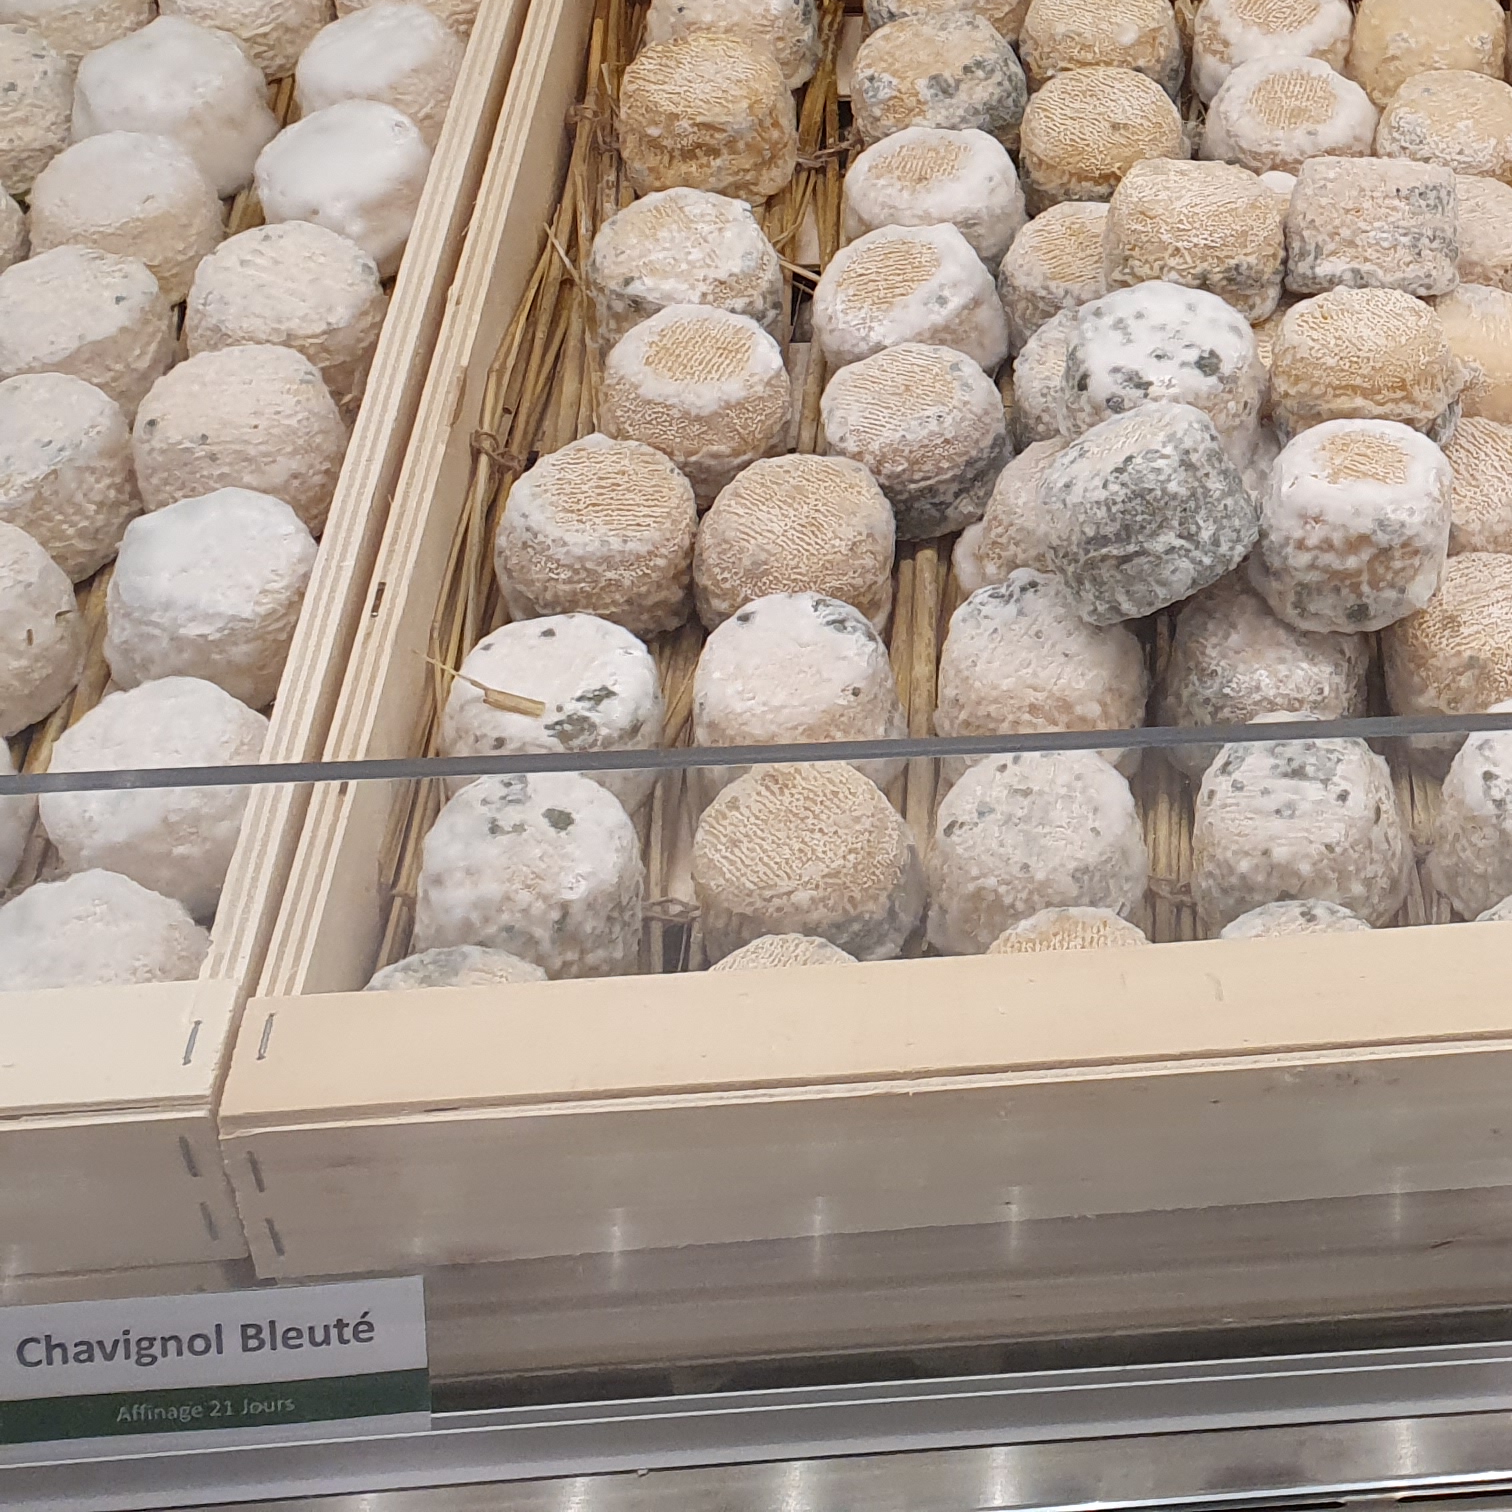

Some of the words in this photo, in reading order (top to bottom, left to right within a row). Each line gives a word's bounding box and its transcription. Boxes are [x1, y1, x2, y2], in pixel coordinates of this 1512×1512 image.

[15, 1322, 224, 1369] Chavignol
[240, 1311, 376, 1353] Bleuté
[116, 1401, 202, 1424] Affinage
[209, 1399, 234, 1418] 21
[240, 1395, 296, 1416] Jours
